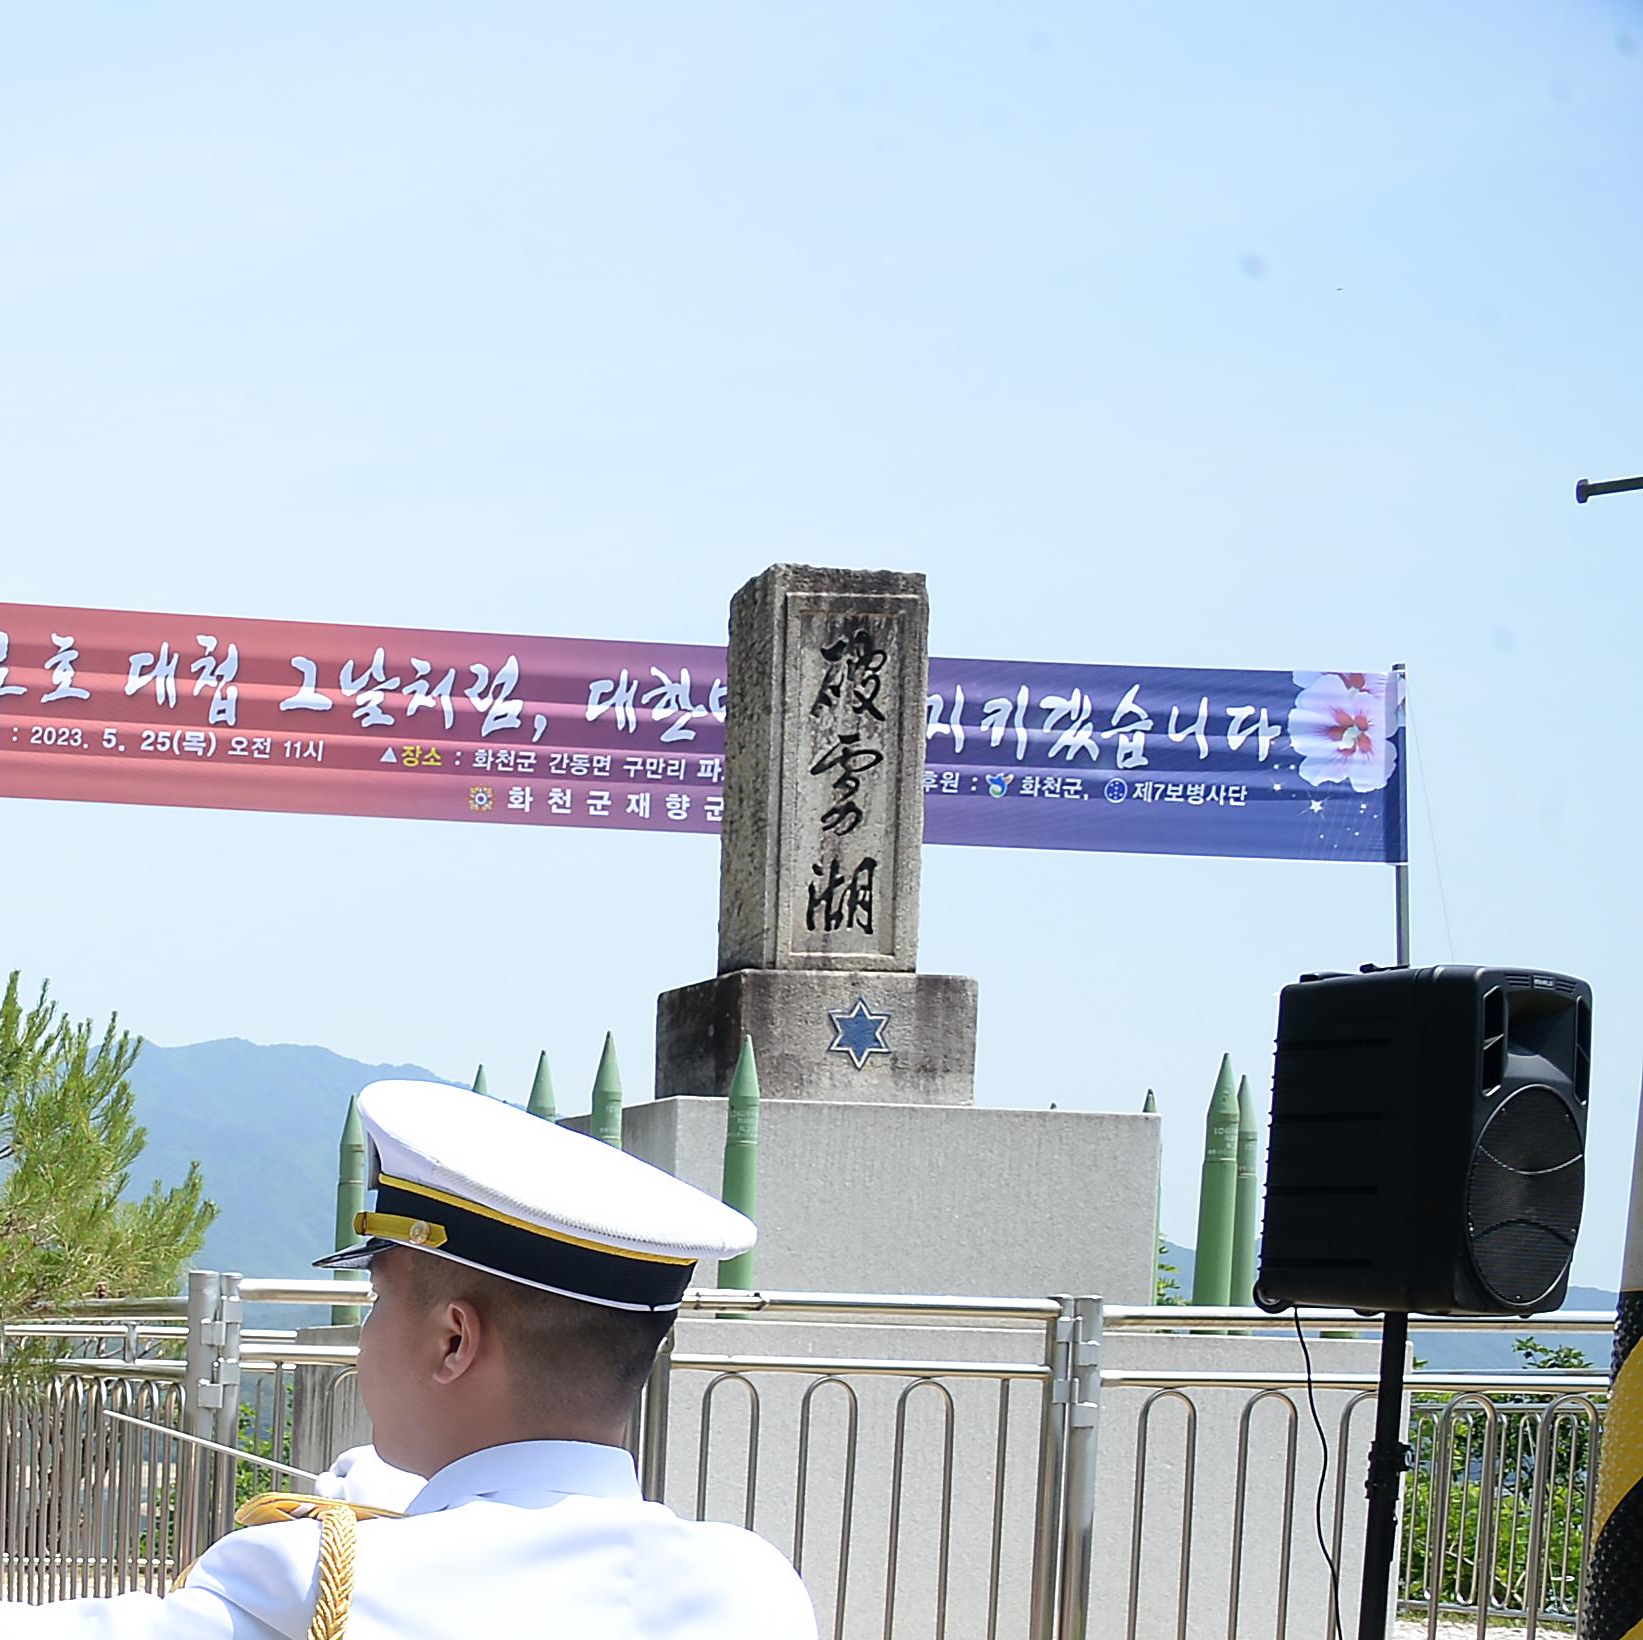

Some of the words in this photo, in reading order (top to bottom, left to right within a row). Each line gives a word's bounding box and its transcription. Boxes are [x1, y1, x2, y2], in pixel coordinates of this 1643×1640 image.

[124, 634, 239, 727] 대첩
[278, 646, 548, 744] 그날처럼,
[29, 725, 90, 750] 2023.
[101, 727, 126, 752] 5.
[140, 730, 218, 758] 25(목)
[227, 736, 272, 760] 오전
[283, 740, 326, 763] 11시
[400, 744, 444, 768] 장소
[471, 748, 538, 774] 화천군
[548, 752, 613, 777] 간동면
[622, 756, 687, 781] 구만리
[696, 757, 725, 784] 파
[925, 683, 1282, 770] 지키겠습니다
[1018, 775, 1089, 801] 화천군,
[1131, 780, 1249, 807] 제7보병사단
